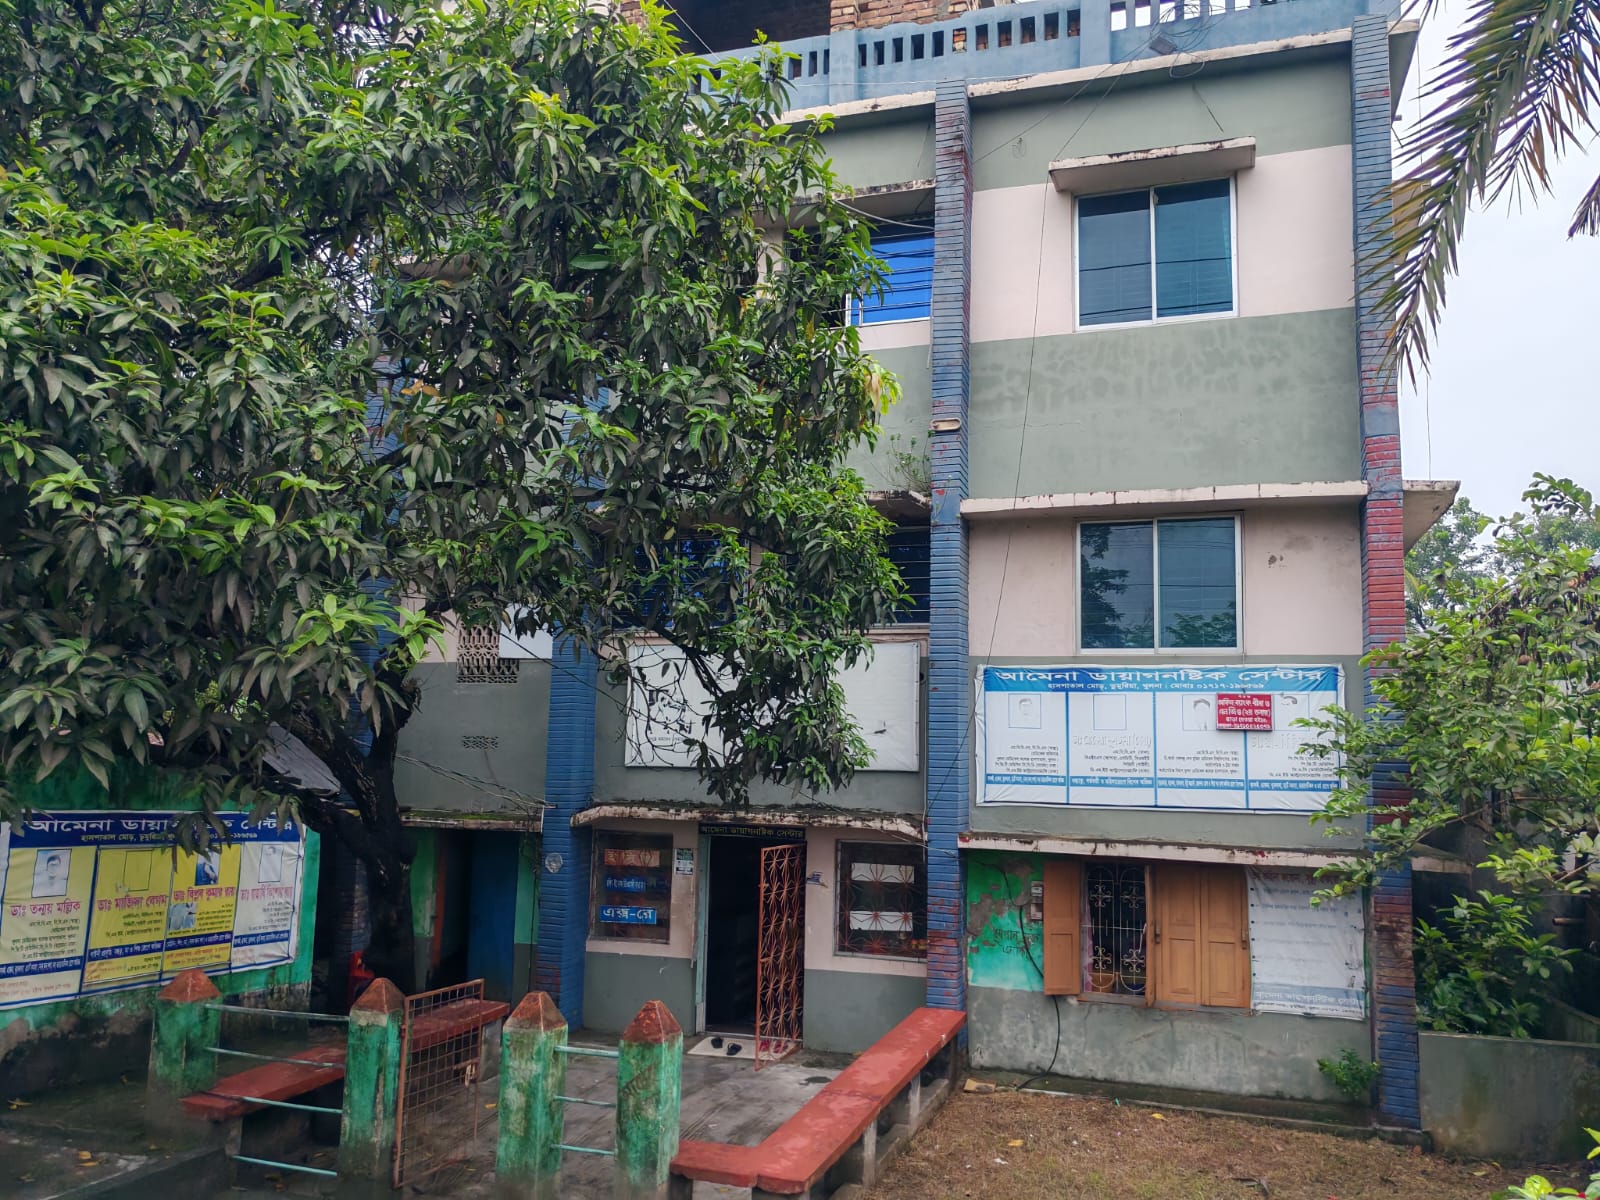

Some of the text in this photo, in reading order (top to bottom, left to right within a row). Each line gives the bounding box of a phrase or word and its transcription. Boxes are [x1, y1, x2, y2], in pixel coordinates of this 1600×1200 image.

[995, 670, 1079, 682] আমেনা
[1238, 668, 1325, 682] সেন্টার
[24, 818, 114, 833] আমেনা
[602, 907, 654, 919] এক্স-রে
